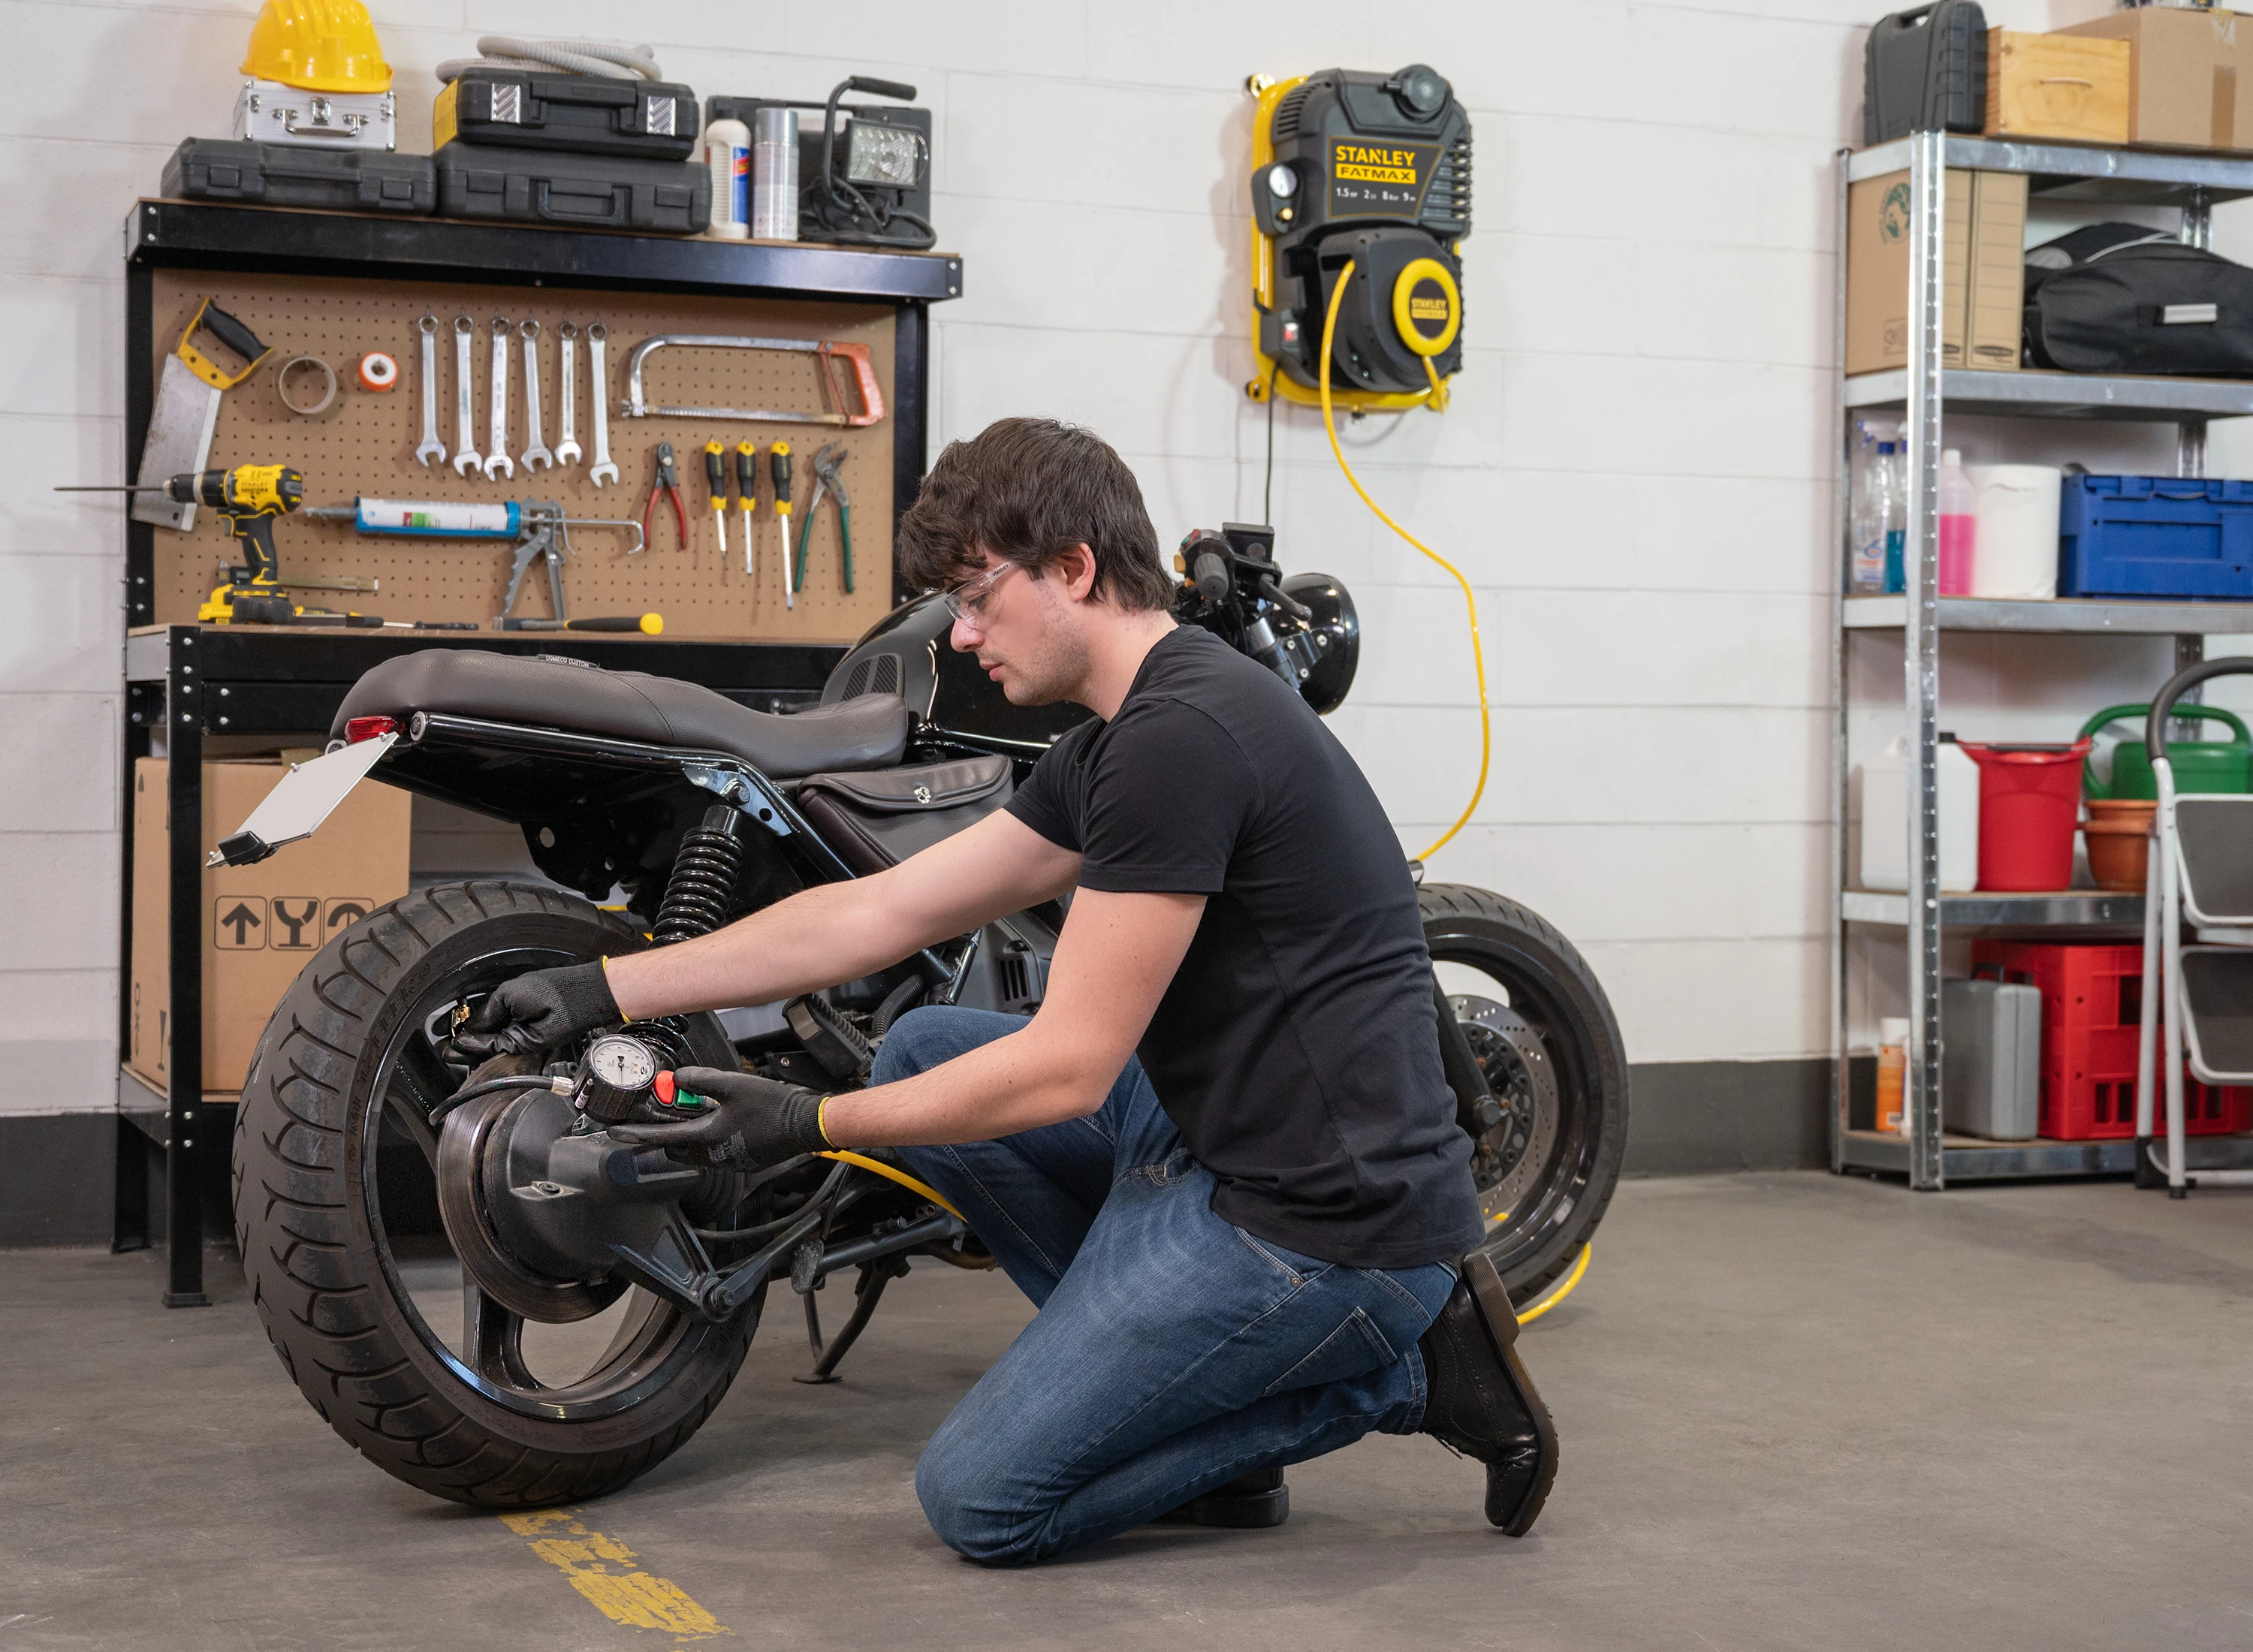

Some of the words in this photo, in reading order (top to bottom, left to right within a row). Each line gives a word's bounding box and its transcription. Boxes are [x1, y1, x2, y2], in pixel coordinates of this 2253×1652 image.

[1336, 145, 1416, 167] STANLEY
[1341, 167, 1410, 180] FATMAX
[992, 564, 1009, 577] STANLEY
[546, 655, 567, 663] COMECO
[569, 658, 590, 668] CUSTOM
